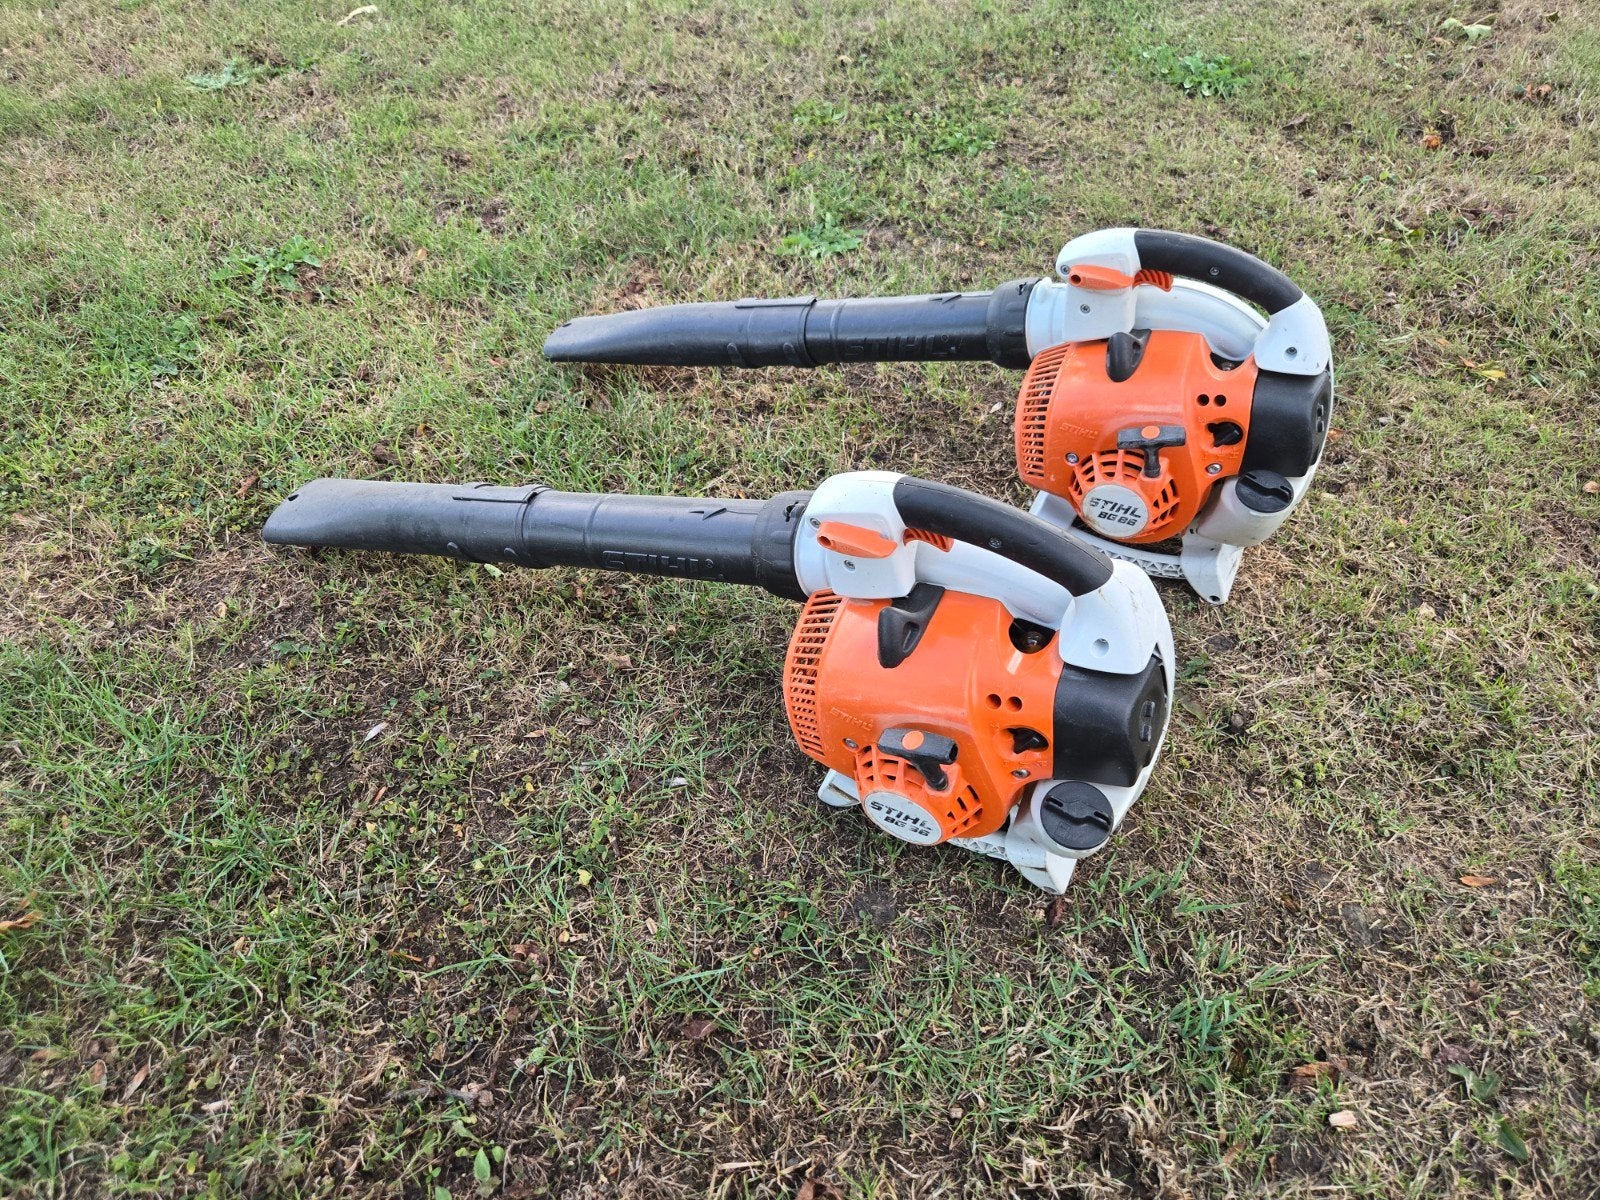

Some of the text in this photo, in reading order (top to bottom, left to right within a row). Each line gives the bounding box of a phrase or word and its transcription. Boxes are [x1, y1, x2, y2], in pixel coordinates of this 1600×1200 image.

[1089, 497, 1141, 518] STIHL
[1097, 511, 1118, 521] BG
[869, 800, 932, 831] STIHL
[884, 816, 907, 828] BG
